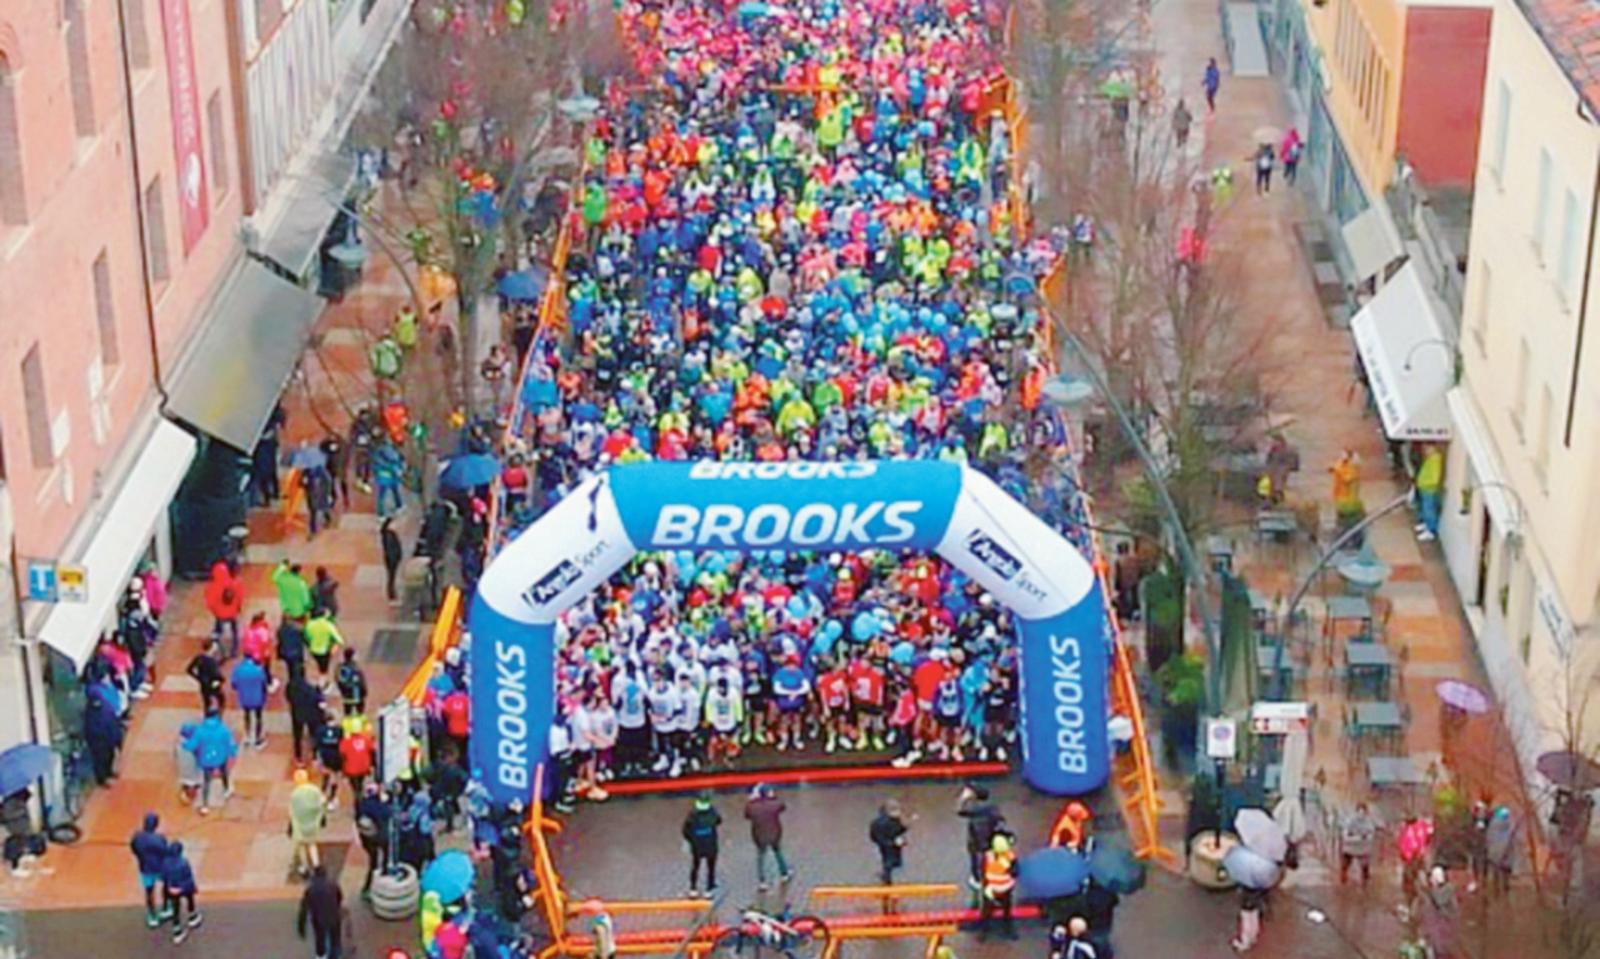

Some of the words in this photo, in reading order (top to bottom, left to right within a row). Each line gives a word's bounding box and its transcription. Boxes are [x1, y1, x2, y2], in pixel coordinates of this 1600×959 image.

[688, 459, 878, 480] BROOKS
[651, 500, 924, 546] BROOKS
[494, 639, 528, 790] BROOKS
[1049, 633, 1088, 774] BROOKS
